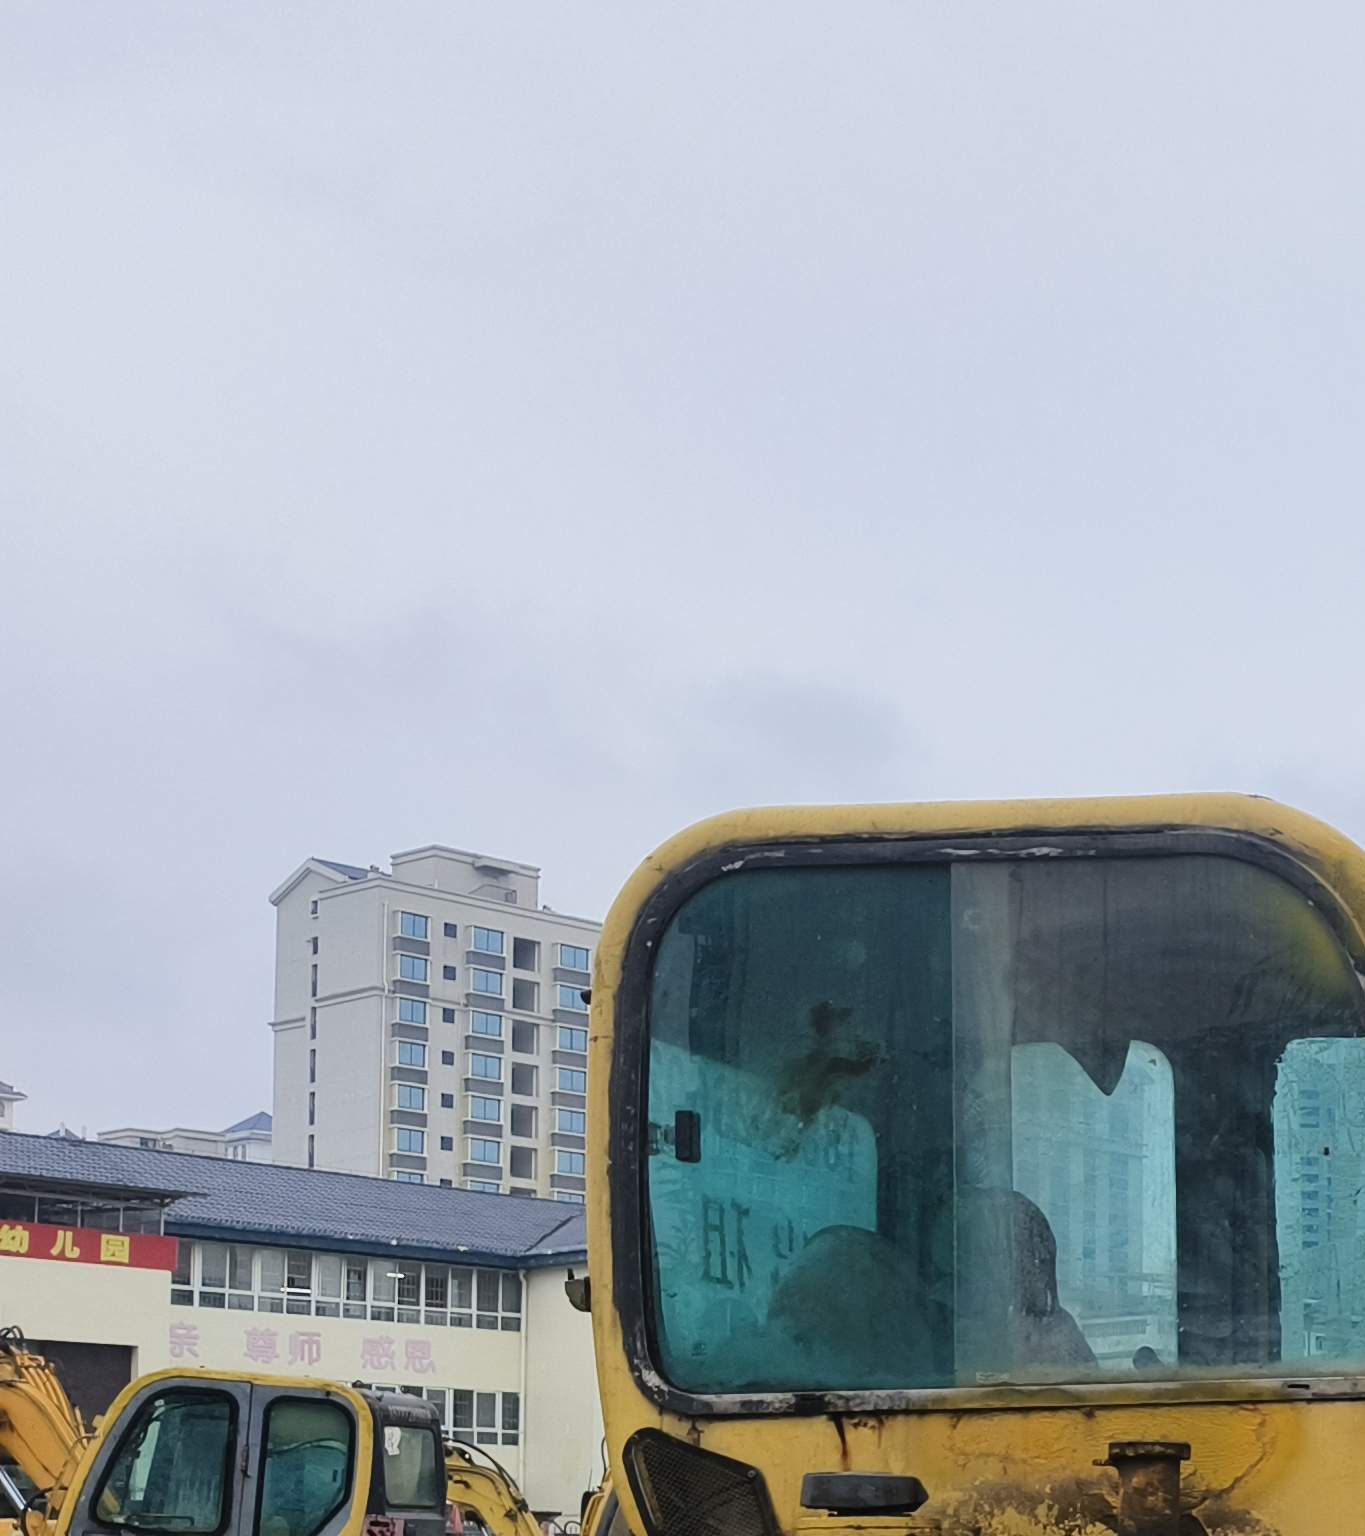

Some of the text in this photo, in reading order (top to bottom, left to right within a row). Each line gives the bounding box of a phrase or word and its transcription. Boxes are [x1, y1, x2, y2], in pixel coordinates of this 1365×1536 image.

[0, 1223, 130, 1264] 幼儿园
[243, 1328, 322, 1366] 尊师
[360, 1335, 437, 1375] 感恩
